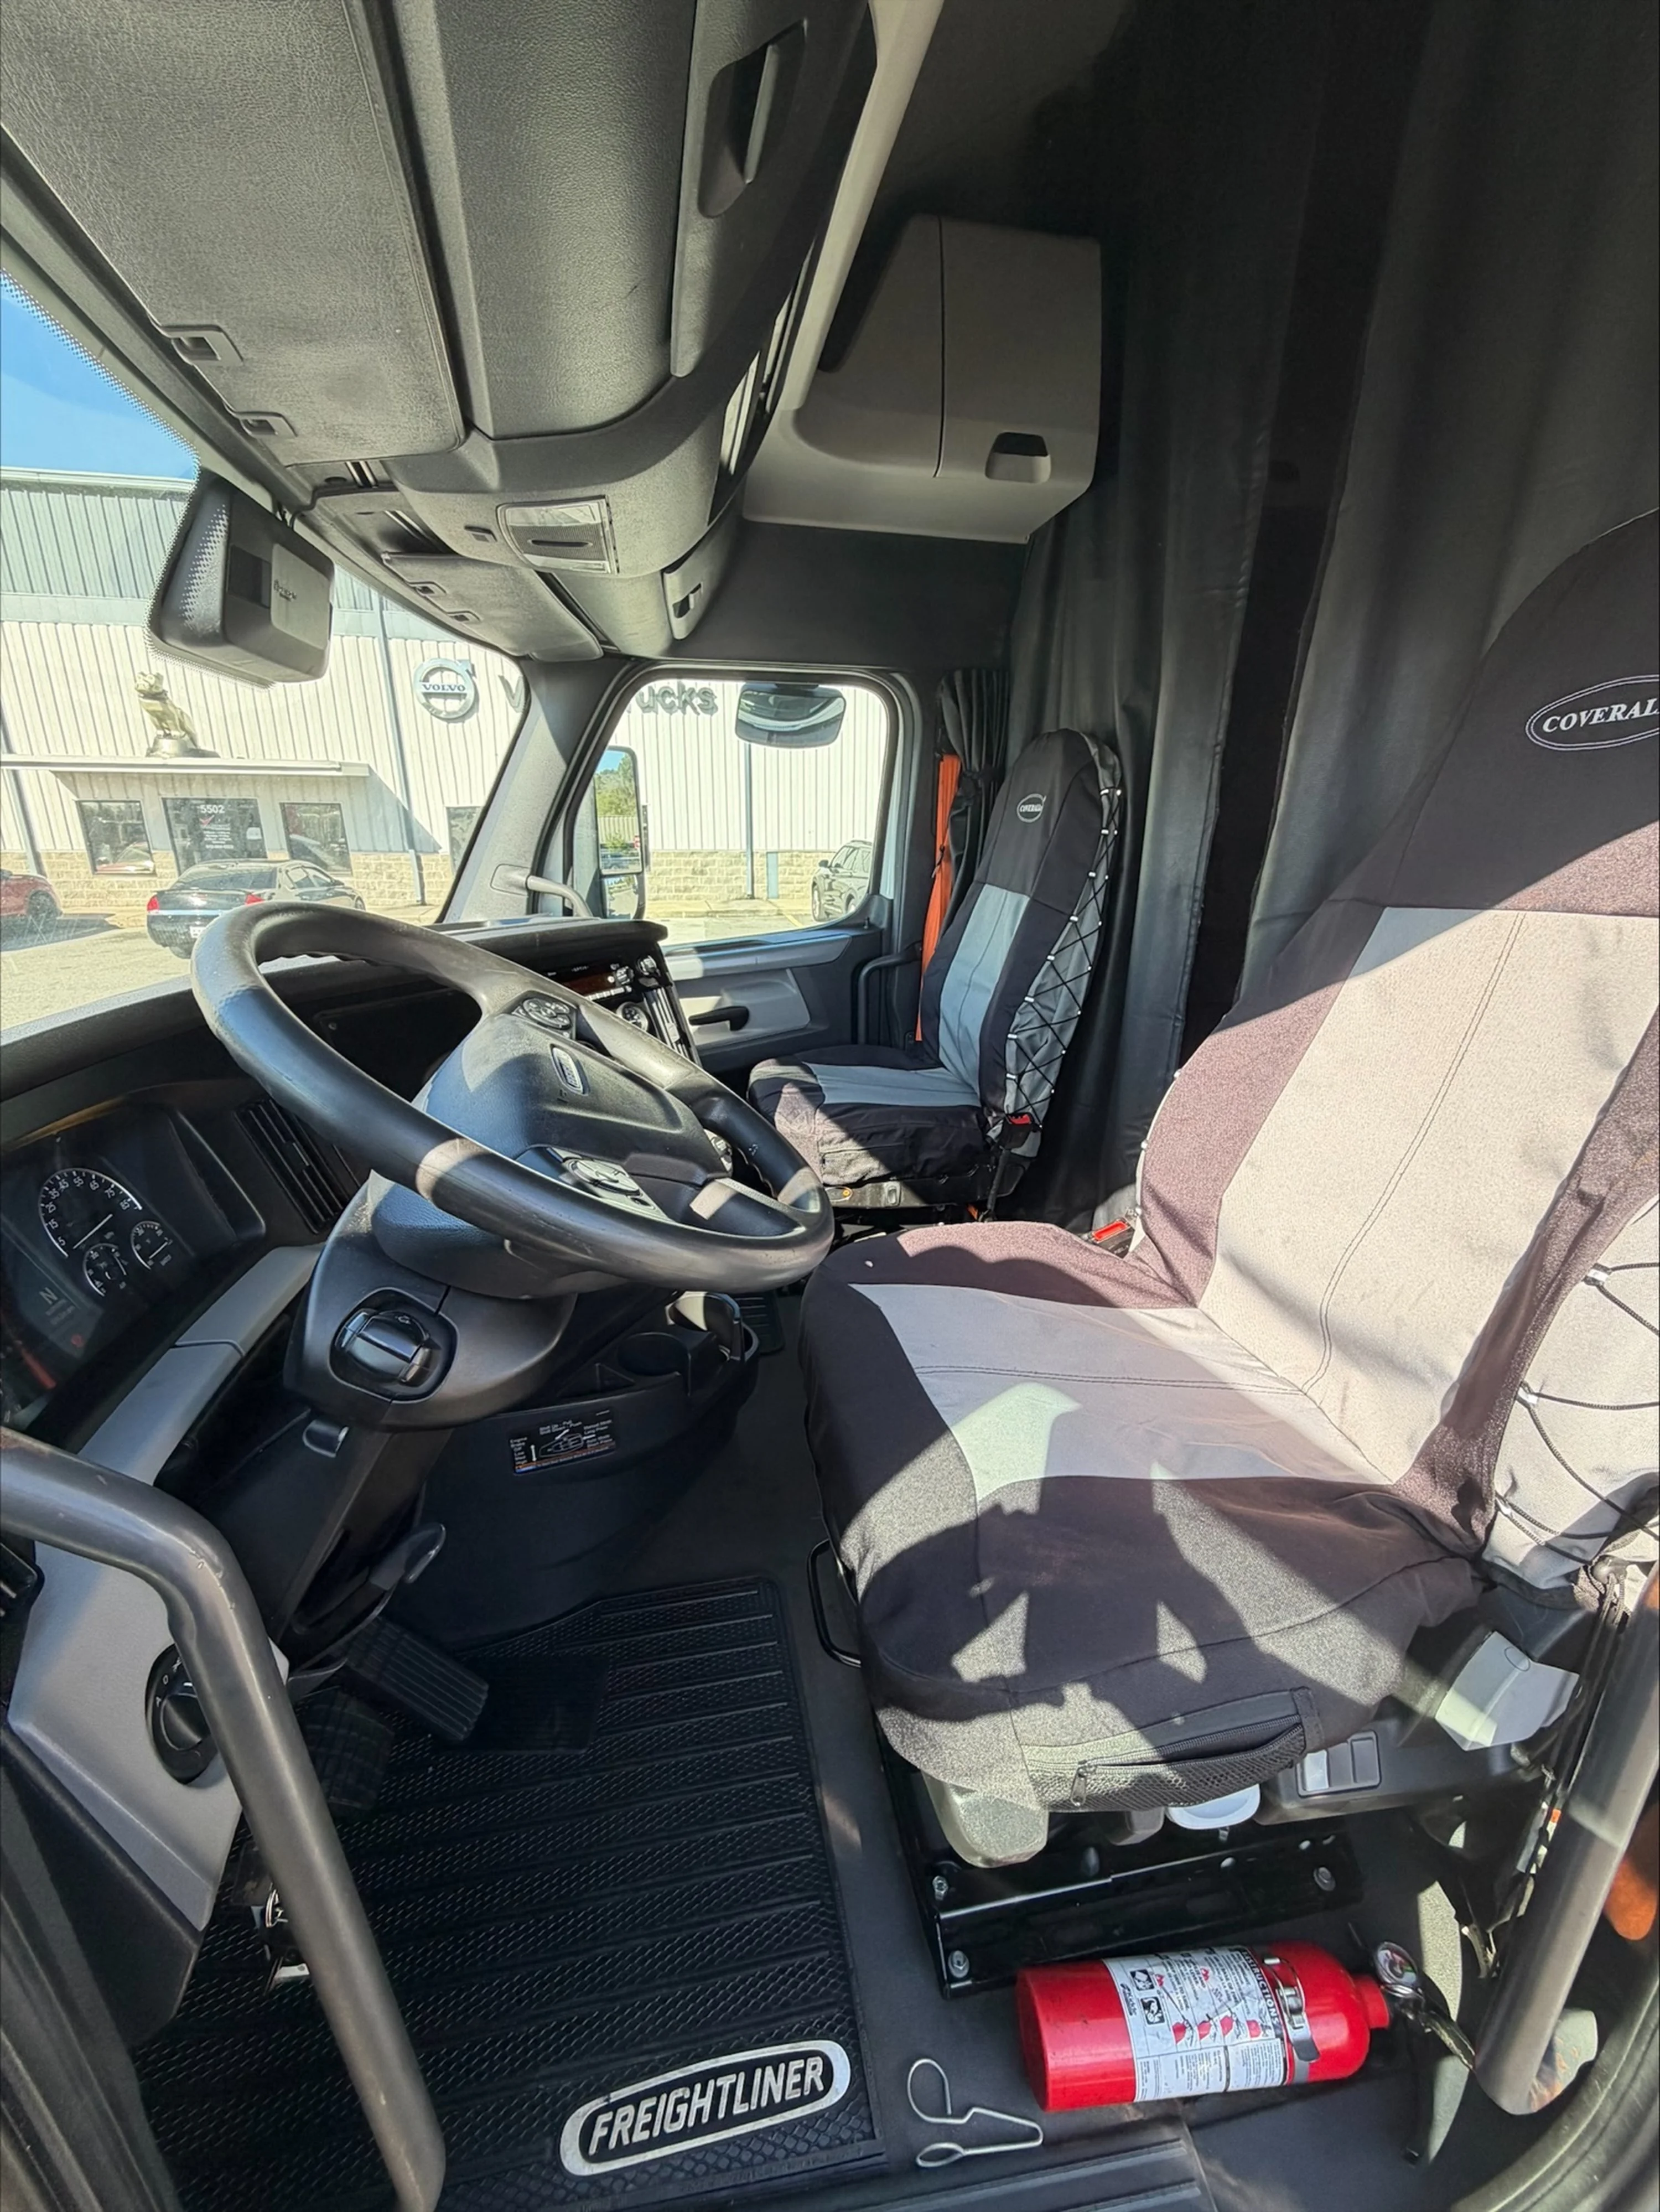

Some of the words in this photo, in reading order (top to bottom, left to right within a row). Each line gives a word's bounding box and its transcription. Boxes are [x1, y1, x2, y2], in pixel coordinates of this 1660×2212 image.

[631, 680, 718, 716] ucks
[1543, 697, 1660, 733] COVERAL
[200, 805, 225, 814] 5502
[58, 1178, 69, 1189] 45
[73, 1176, 84, 1187] 55
[89, 1180, 100, 1190] 65
[48, 1188, 60, 1199] 35
[104, 1188, 115, 1198] 75
[45, 1201, 56, 1213] 25
[49, 1219, 59, 1229] 15
[58, 1236, 66, 1246] 5
[588, 2056, 824, 2156] FREIGHTLINER
